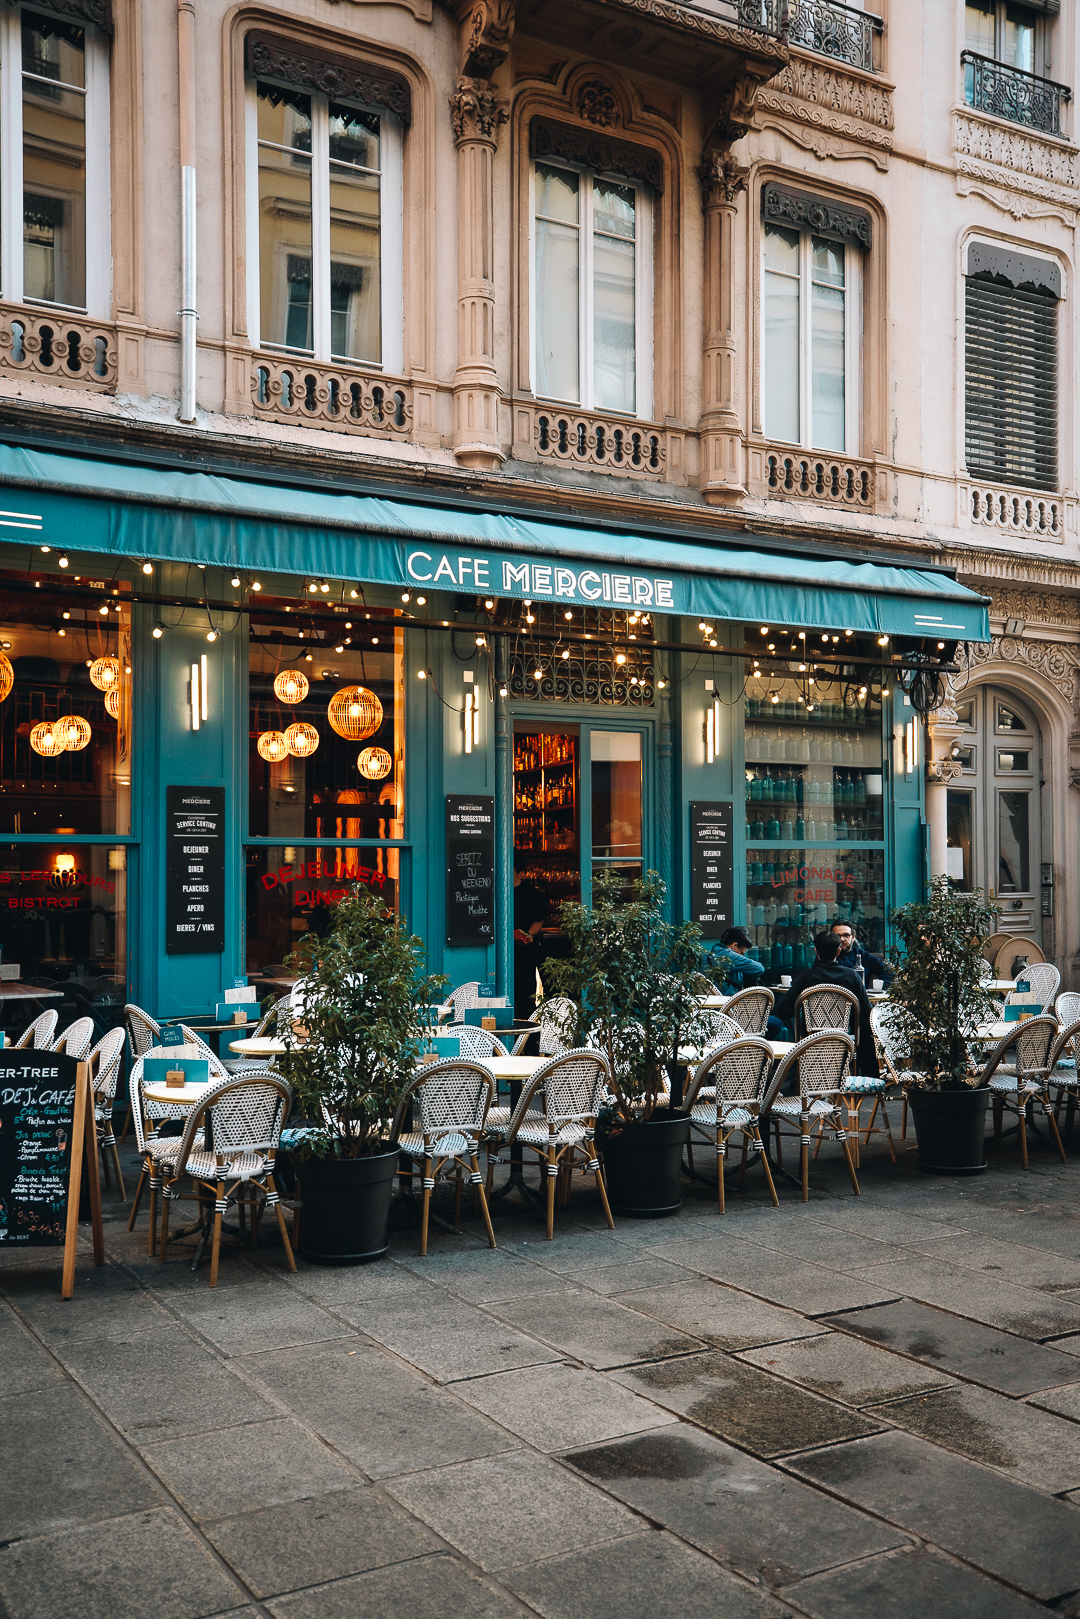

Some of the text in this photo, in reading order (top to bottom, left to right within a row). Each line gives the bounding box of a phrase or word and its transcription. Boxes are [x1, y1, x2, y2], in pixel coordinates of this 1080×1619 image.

[408, 552, 674, 608] CAFE MERCIERE
[1012, 620, 1018, 633] 1
[176, 820, 216, 829] SERVICE CONTINU
[183, 846, 209, 854] DEJEUNER
[456, 852, 482, 865] SPRITZ
[261, 862, 386, 890] DEJEUNER
[468, 868, 476, 876] DU
[771, 867, 856, 888] LIMONADE
[21, 870, 52, 881] LES
[62, 872, 116, 893] JOURS
[462, 877, 491, 887] WEEKEND
[182, 885, 209, 893] PLANCHES
[295, 890, 358, 906] DINE
[794, 889, 834, 902] CAFE
[8, 898, 81, 908] BISTROT
[468, 904, 488, 915] Menthe
[176, 924, 195, 932] BIERES
[202, 923, 214, 931] VINS
[15, 1131, 29, 1139] Jus
